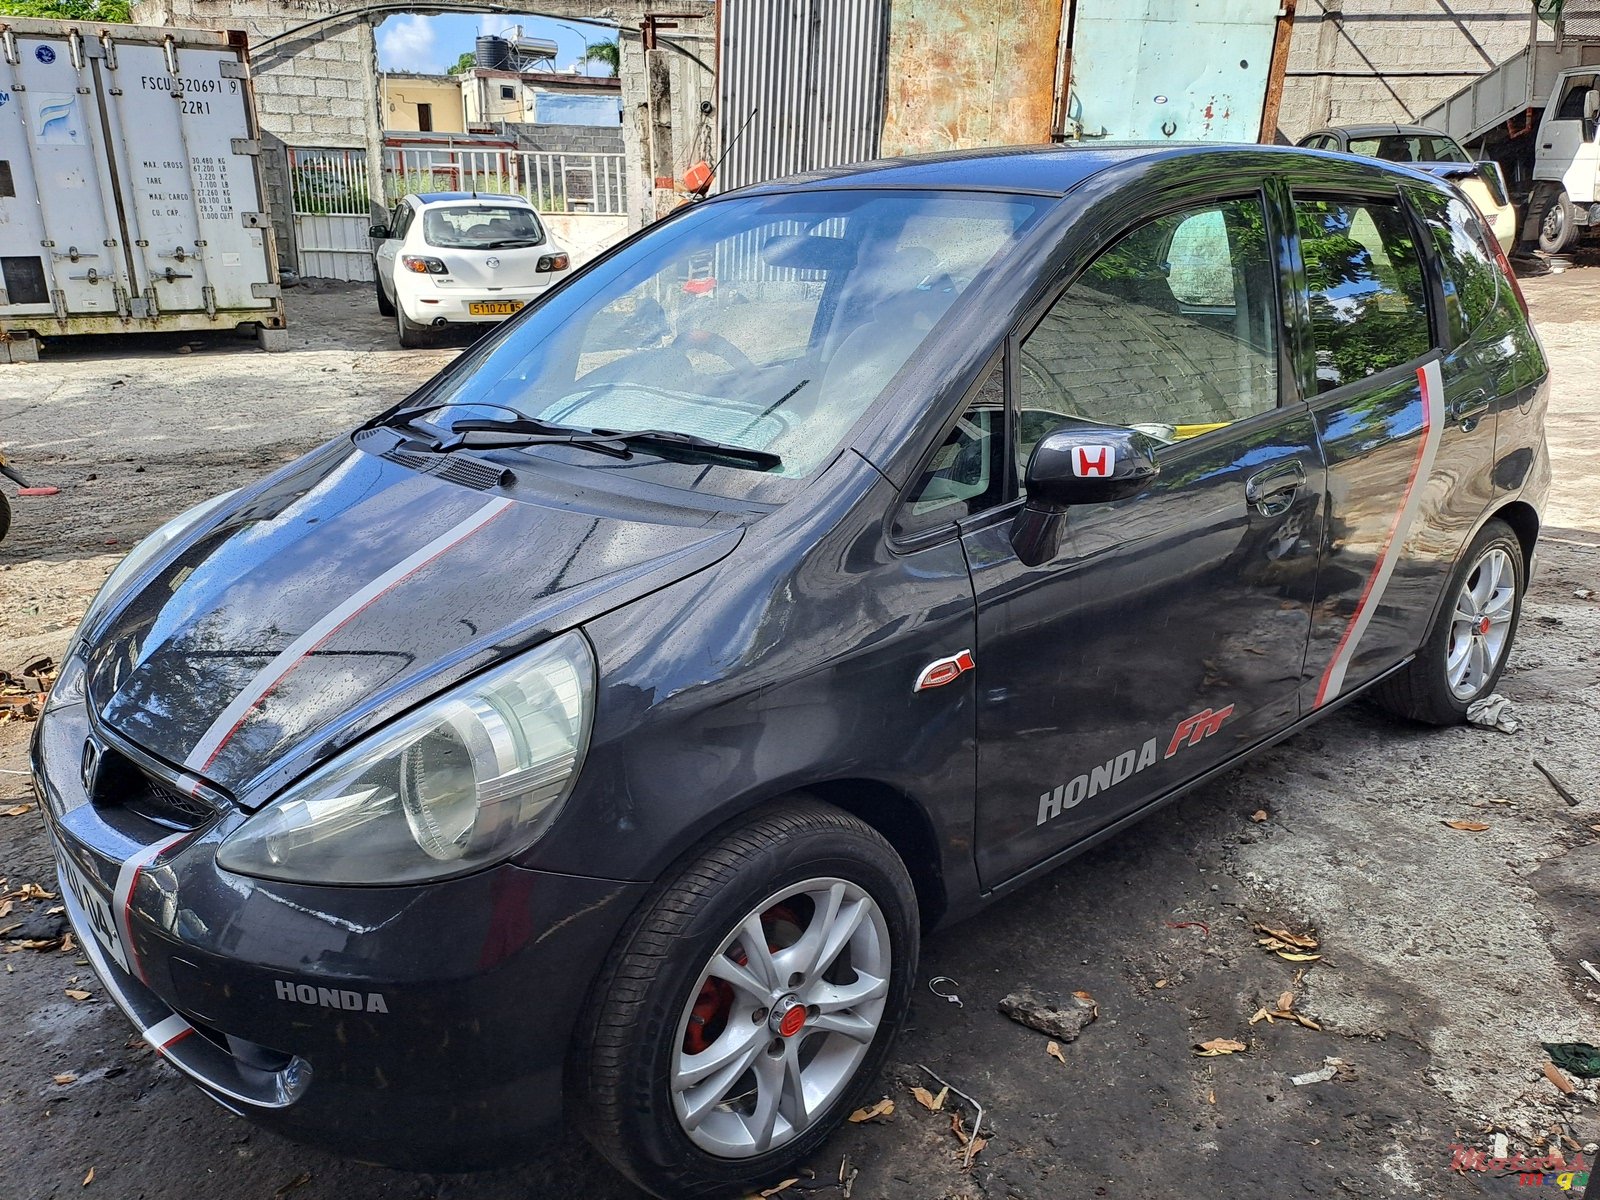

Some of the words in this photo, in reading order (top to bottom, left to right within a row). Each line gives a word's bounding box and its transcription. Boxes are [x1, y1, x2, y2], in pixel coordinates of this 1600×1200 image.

[141, 76, 171, 91] FSCU
[177, 78, 222, 93] 520691
[181, 101, 210, 115] 22R1
[163, 161, 184, 169] GROSS
[474, 304, 496, 313] 5110
[497, 304, 508, 313] ZT
[1036, 737, 1158, 827] HONDA
[274, 979, 390, 1015] HONDA
